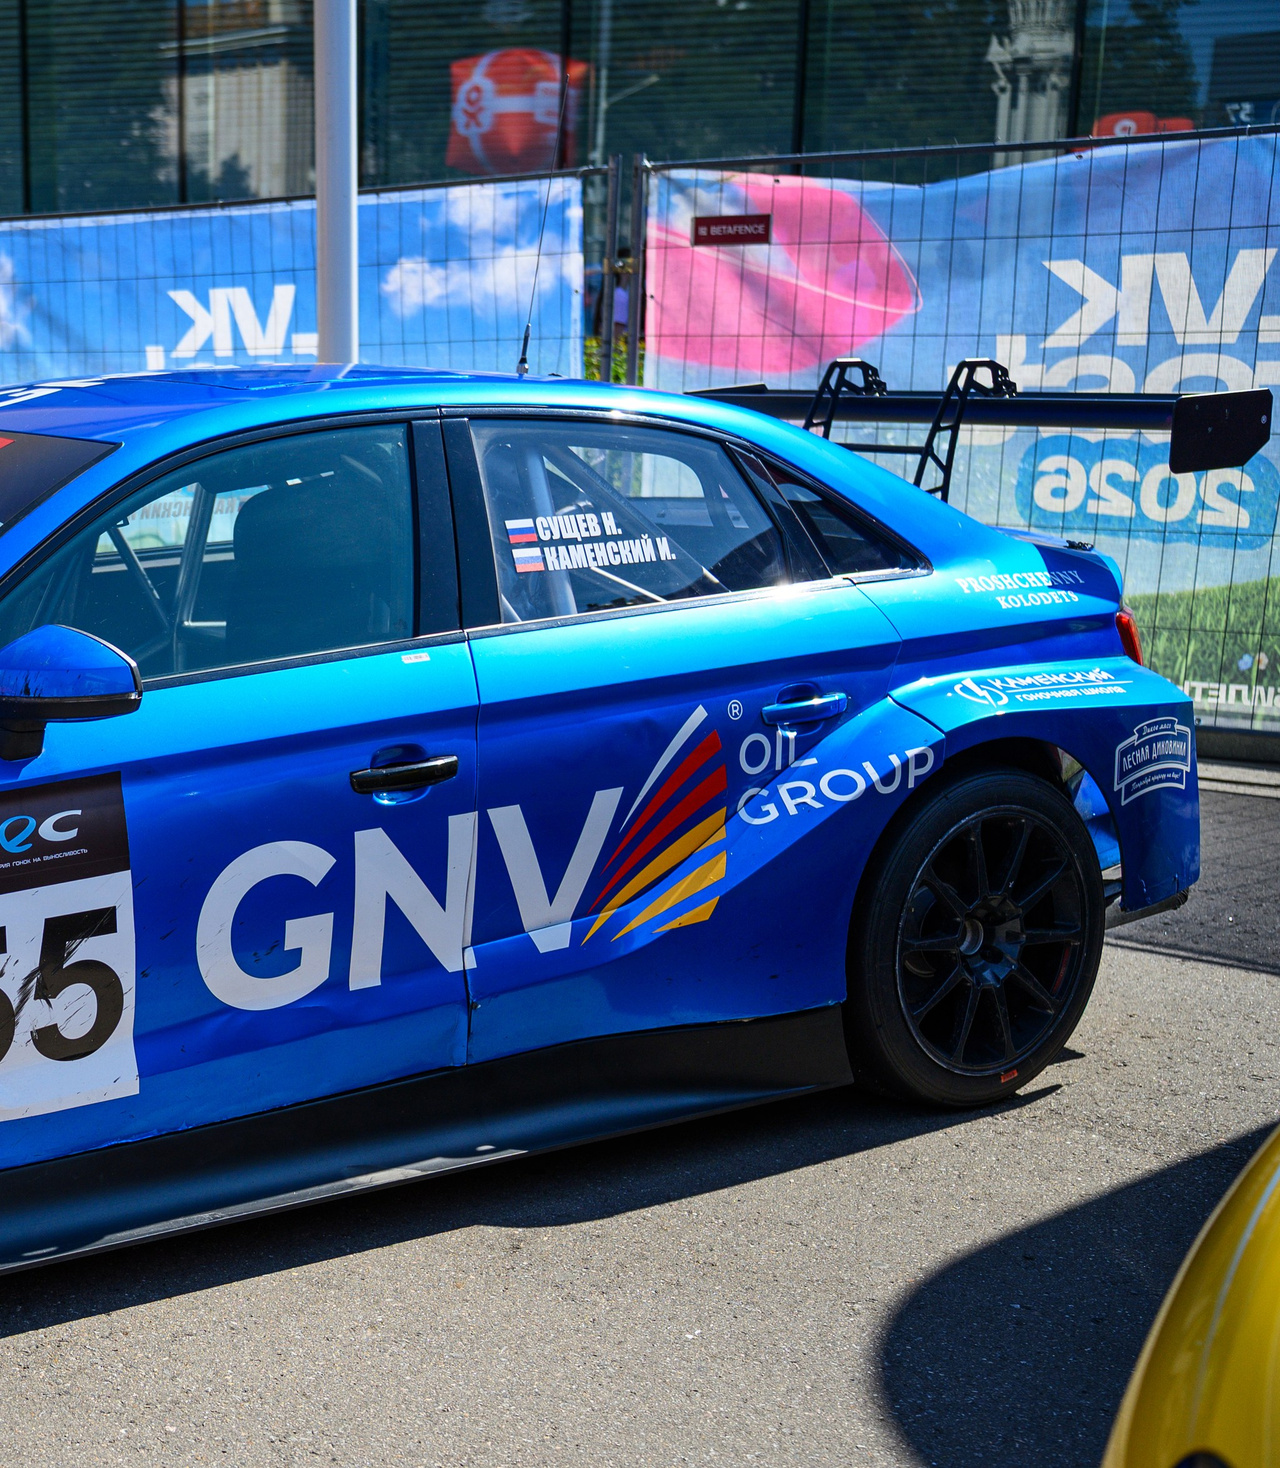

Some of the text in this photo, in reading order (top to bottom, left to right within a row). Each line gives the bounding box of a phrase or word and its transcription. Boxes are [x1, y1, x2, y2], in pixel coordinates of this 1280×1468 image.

[709, 223, 765, 236] BETAFENCE
[535, 512, 622, 541] СУЩЕВ Н.
[543, 533, 677, 571] КАМЕНСКИЙ И.
[955, 570, 1085, 593] PROSHCHENNY
[996, 590, 1079, 609] KOLODETS
[739, 728, 818, 775] OIL
[1122, 740, 1187, 772] ЛЕСНАЯ ДИКОВИНКА
[736, 746, 935, 825] GROUP
[12, 858, 31, 867] ГОНОК
[43, 848, 88, 861] ВЫНОСЛИВОСТЬ
[196, 787, 624, 1011] GNV
